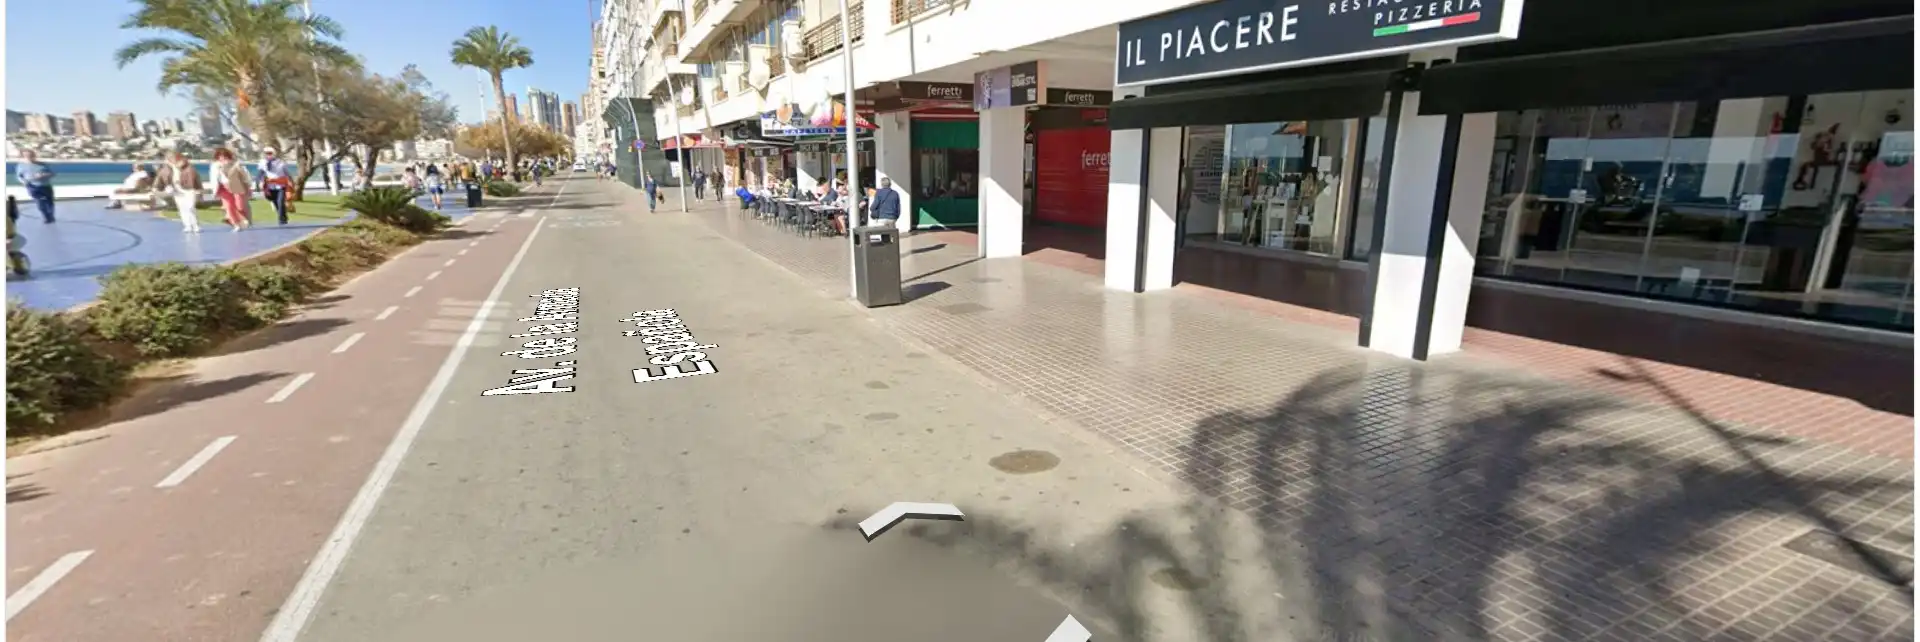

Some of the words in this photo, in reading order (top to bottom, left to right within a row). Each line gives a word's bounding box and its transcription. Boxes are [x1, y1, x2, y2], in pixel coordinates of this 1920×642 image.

[1374, 0, 1483, 25] PIZZERIA
[1125, 40, 1146, 67] IL
[1160, 5, 1300, 62] PIACERE
